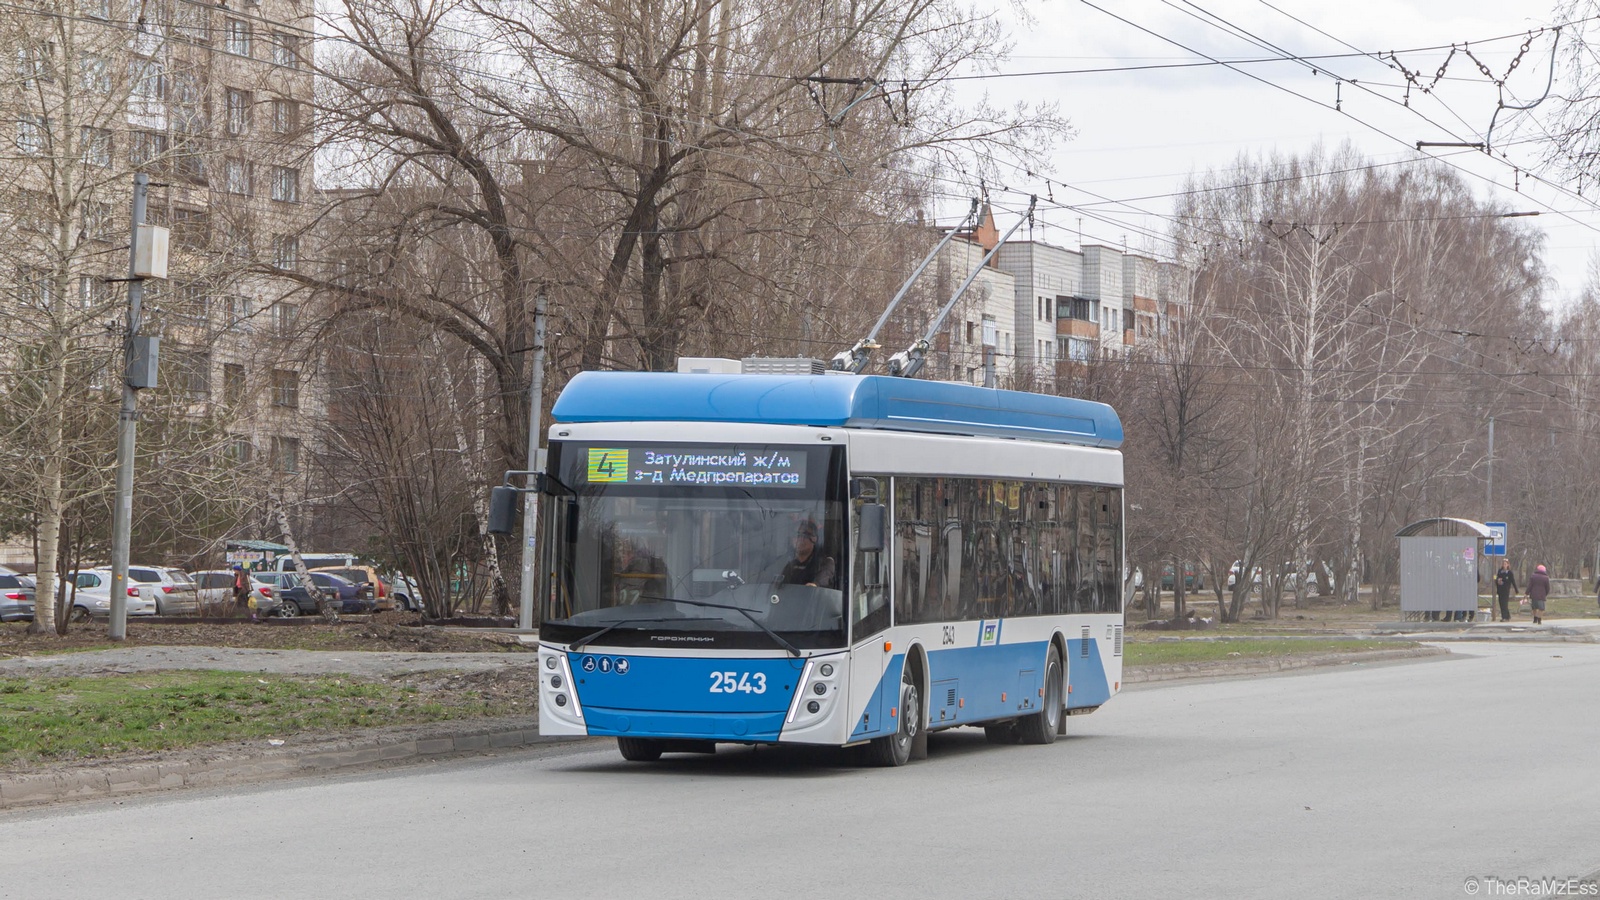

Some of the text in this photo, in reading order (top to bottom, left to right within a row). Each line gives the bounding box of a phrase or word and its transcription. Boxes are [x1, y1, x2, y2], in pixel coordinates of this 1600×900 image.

[597, 453, 615, 478] 4
[645, 451, 791, 468] Затулинский ж/м
[634, 468, 799, 485] з-д Медпрепаратов
[942, 625, 955, 645] 2543
[709, 671, 767, 694] 2543
